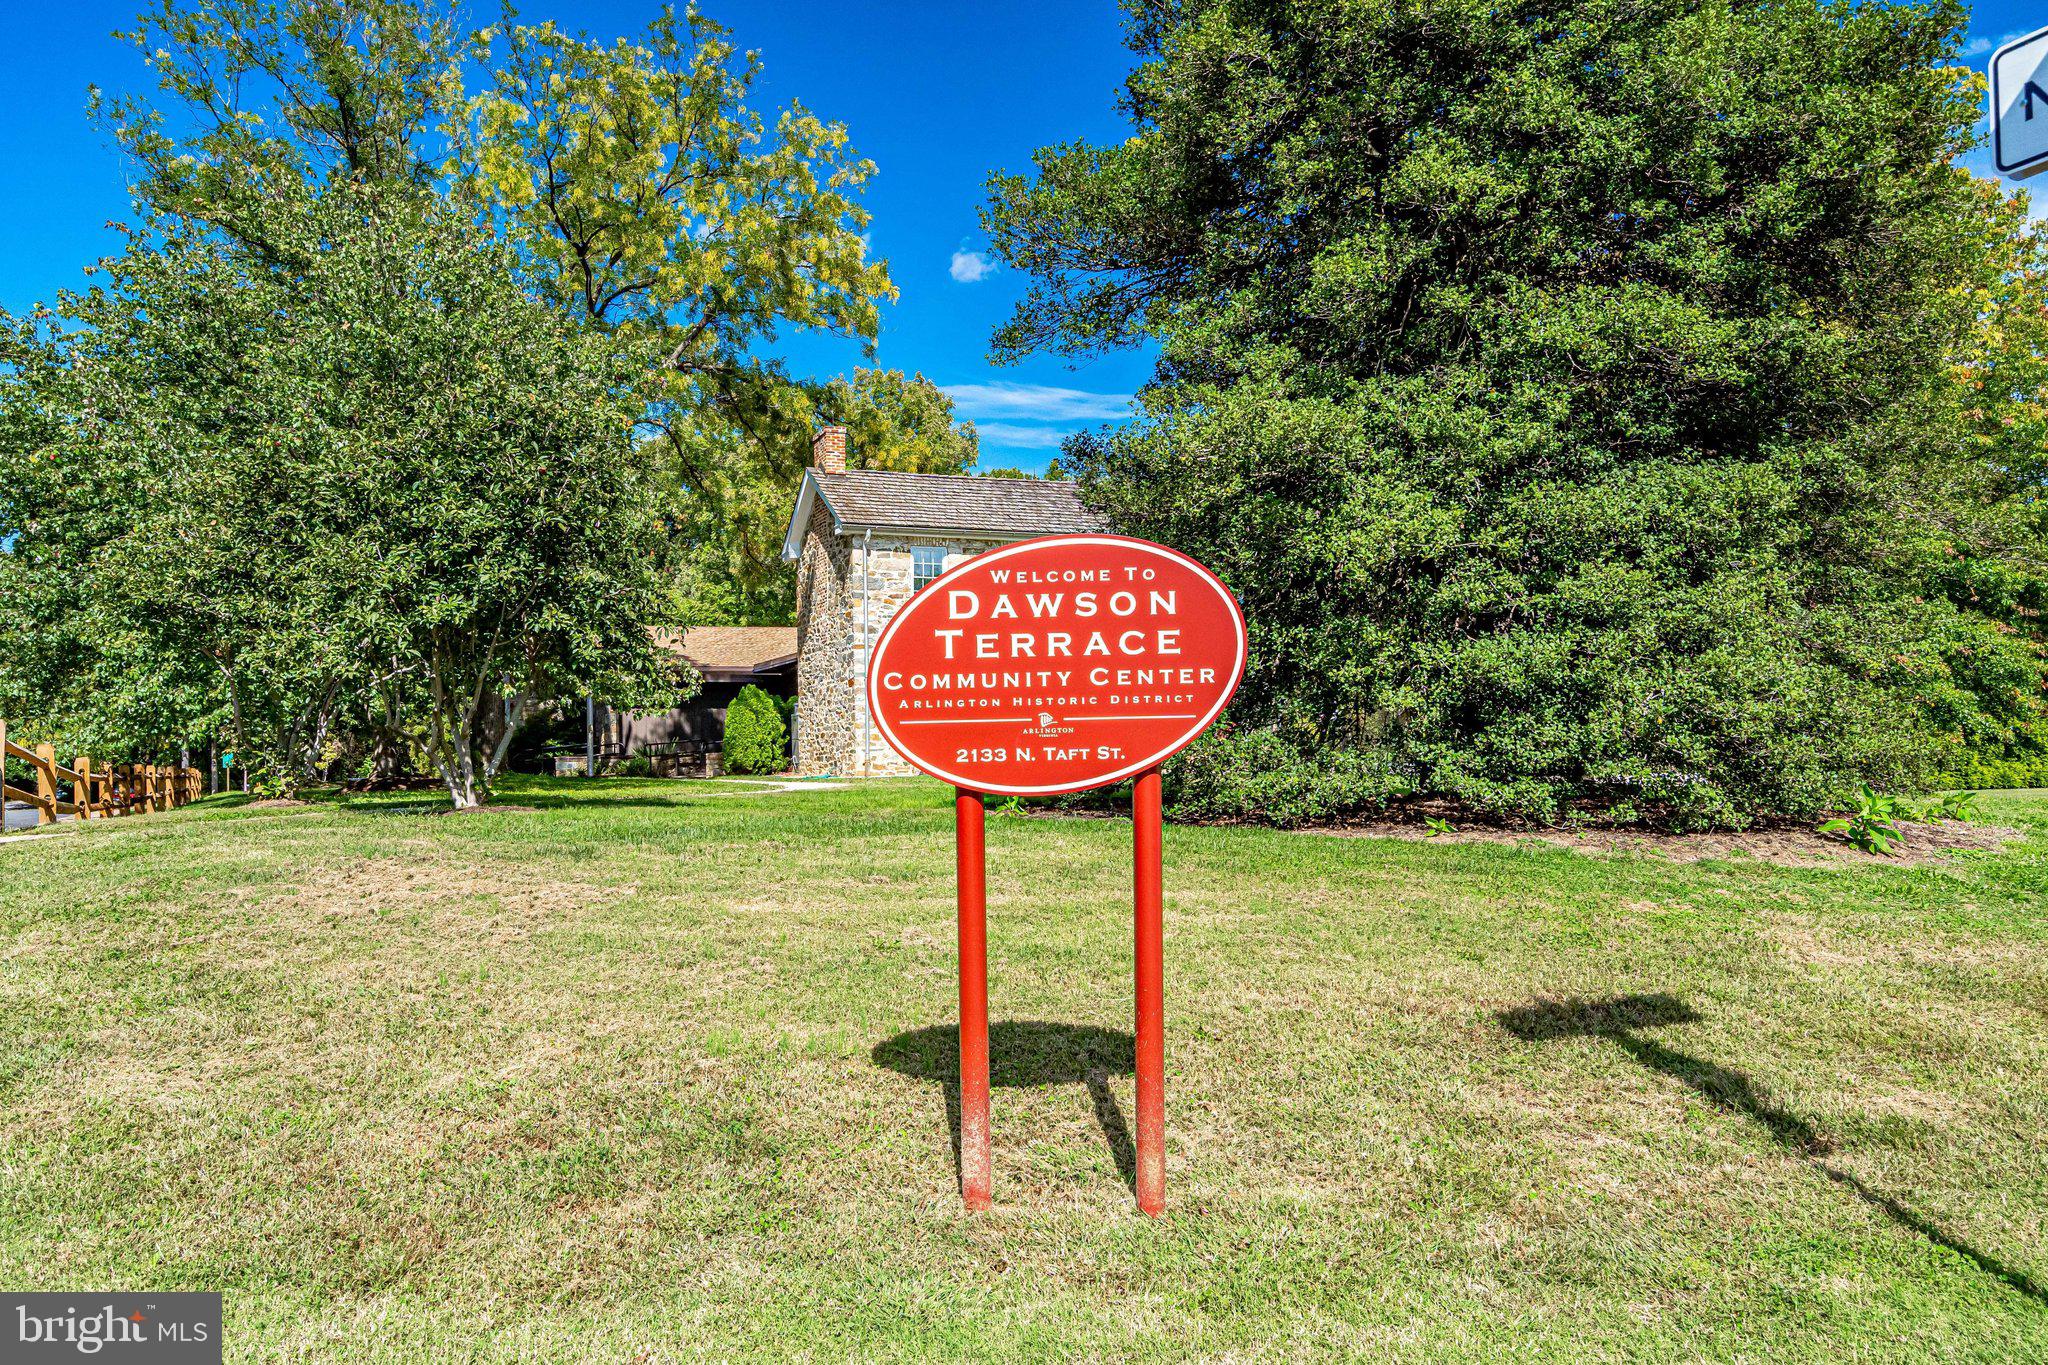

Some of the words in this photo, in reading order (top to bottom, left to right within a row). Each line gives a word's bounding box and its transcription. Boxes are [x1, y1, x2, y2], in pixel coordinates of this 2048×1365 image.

[990, 569, 1111, 583] WELCOME
[1124, 567, 1155, 580] TO
[948, 591, 1177, 620] DAWSON
[935, 629, 1181, 659] TERRACE
[884, 671, 1071, 690] COMMUNITY
[1090, 668, 1215, 686] CENTER
[899, 699, 1000, 708] ARLINGTON
[1013, 697, 1097, 706] HISTORIC
[1110, 695, 1193, 704] DISTRICT
[956, 748, 1007, 762] 2133
[1016, 748, 1035, 761] N.
[1043, 747, 1090, 760] TAFT
[1098, 746, 1125, 759] ST.
